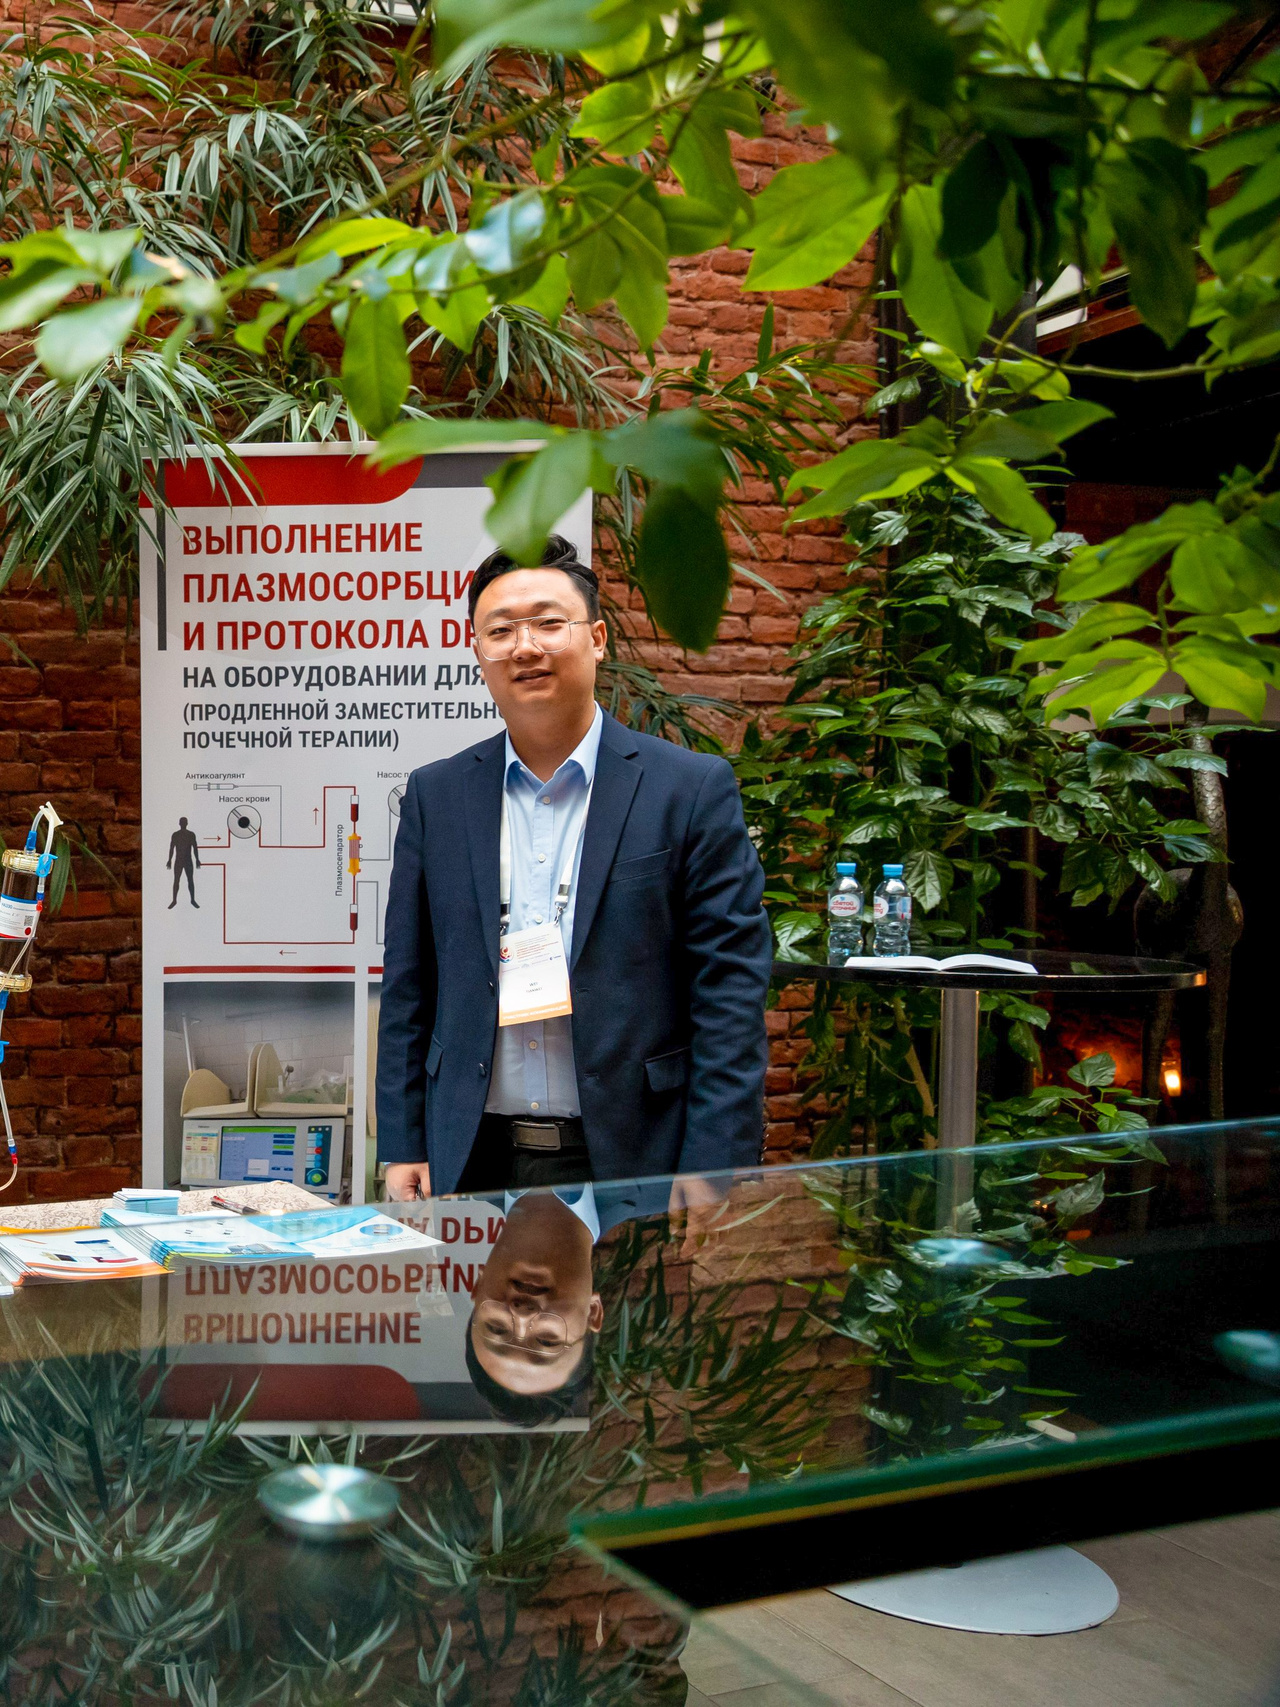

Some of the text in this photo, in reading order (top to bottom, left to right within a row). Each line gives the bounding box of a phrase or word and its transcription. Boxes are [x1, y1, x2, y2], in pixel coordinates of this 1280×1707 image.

[183, 522, 423, 555] ВЫПОЛНЕНИЕ
[183, 570, 474, 606] ПЛАЗМОСОРБЦИ
[183, 621, 204, 651] И
[217, 619, 429, 651] ПРОТОКОЛА
[183, 664, 485, 691] НА ОБОРУДОВАНИИ ДЛЯ
[183, 699, 503, 725] (ПРОДЛЕННОЙ ЗАМЕСТИТЕЛЬН
[183, 727, 399, 752] ПОЧЕЧНОЙ ТЕРАПИИ)
[185, 772, 245, 781] Антикоагулянт
[219, 795, 270, 805] Насос крови
[335, 824, 344, 897] Плазмосепаратор
